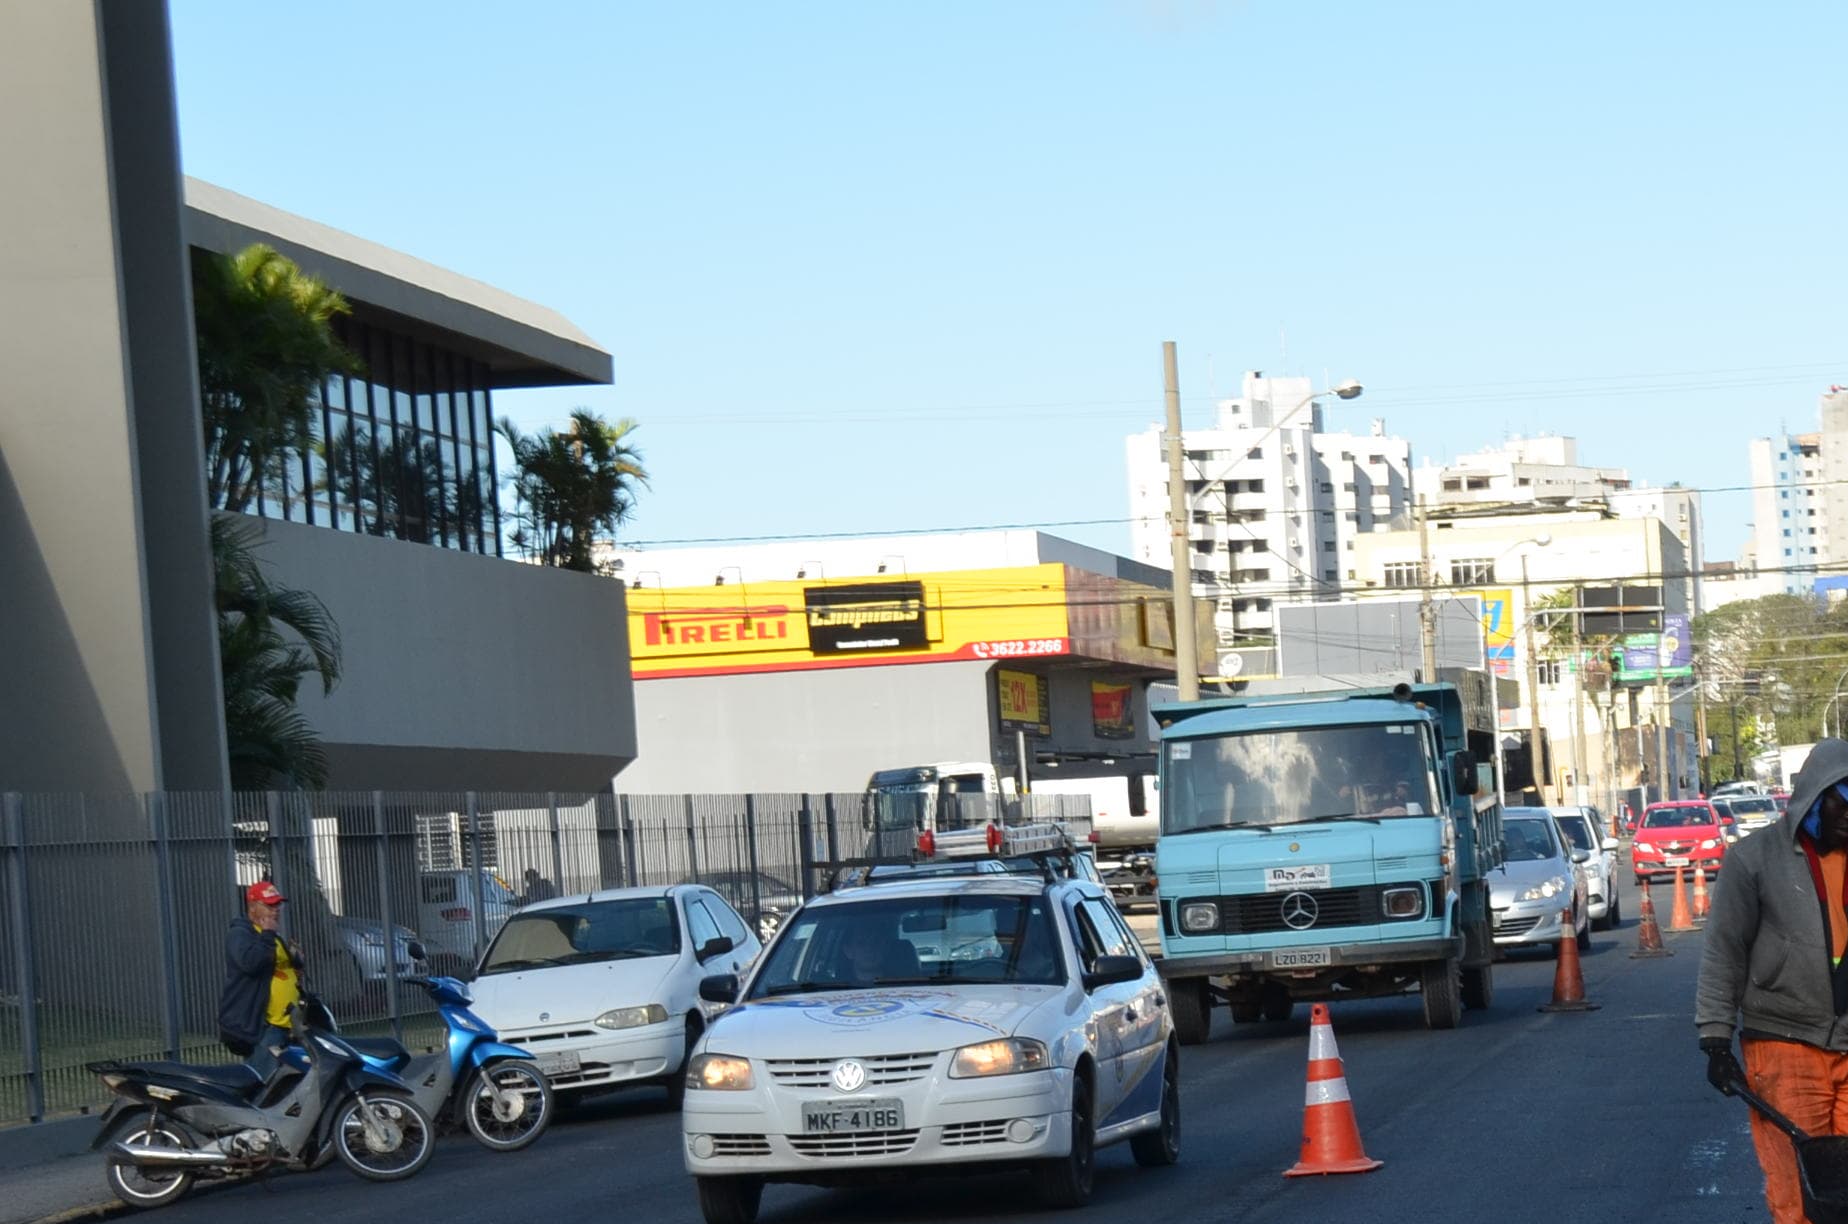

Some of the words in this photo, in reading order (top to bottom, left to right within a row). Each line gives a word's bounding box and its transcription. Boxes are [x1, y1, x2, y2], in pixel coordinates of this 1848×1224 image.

[643, 604, 788, 647] PIRELLI
[989, 639, 1062, 656] 3622.2266
[807, 1109, 898, 1131] MKF-4186
